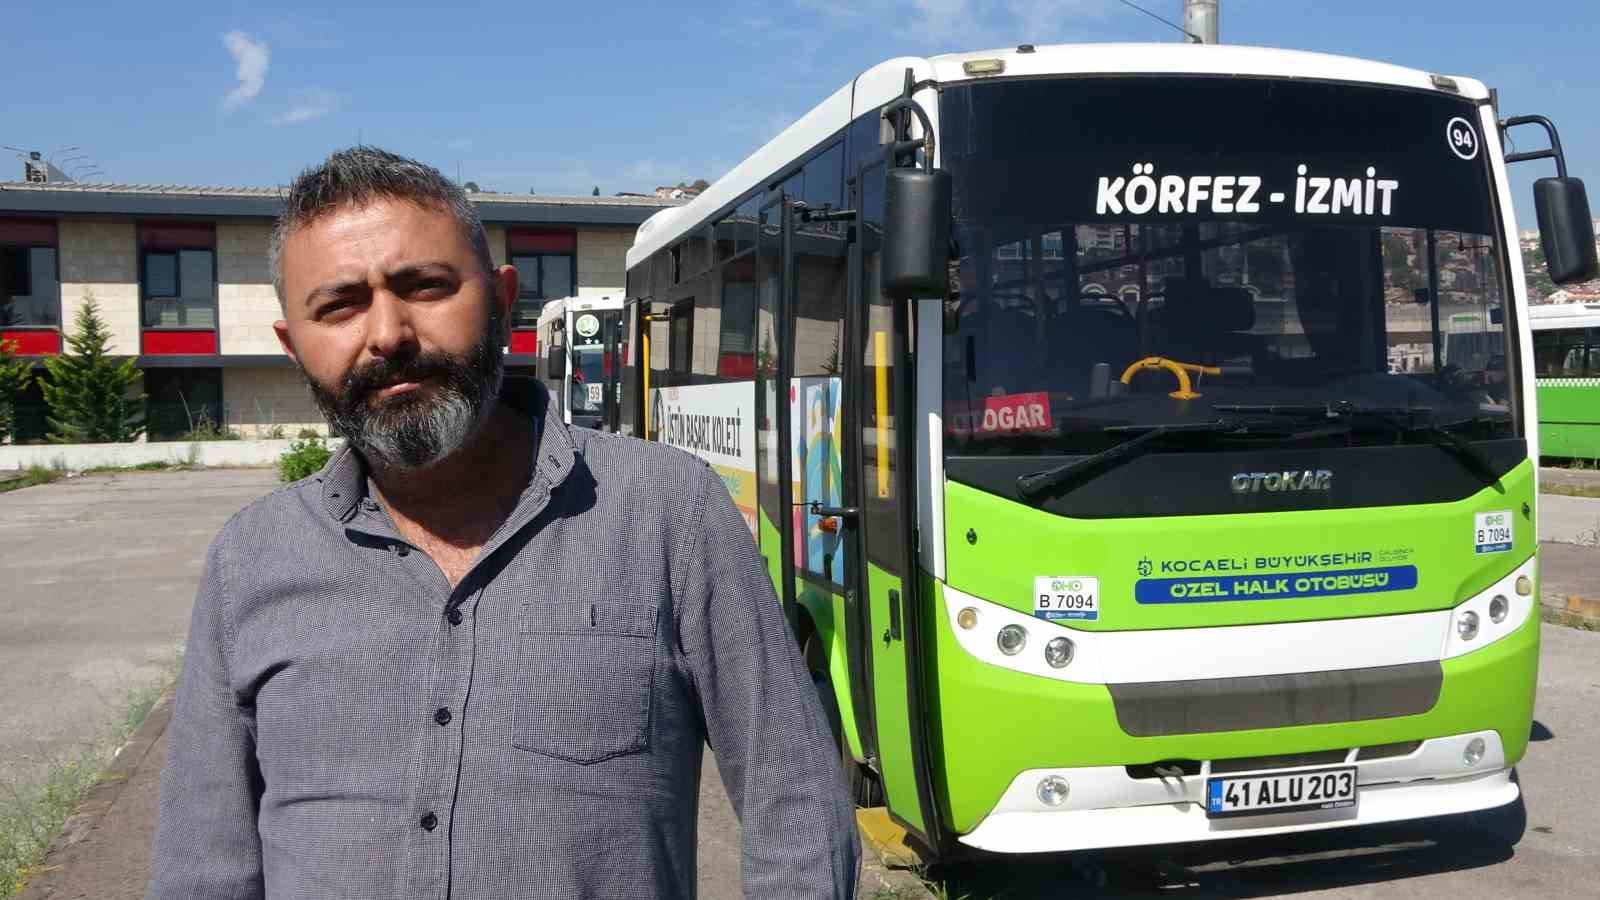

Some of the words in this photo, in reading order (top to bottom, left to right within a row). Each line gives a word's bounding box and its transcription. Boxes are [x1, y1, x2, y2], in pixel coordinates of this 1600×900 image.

[1453, 128, 1473, 148] 94
[1096, 162, 1262, 215] KÖRFEZ
[1294, 163, 1399, 215] İZMİT
[1231, 469, 1333, 493] OTOKAR
[1477, 529, 1485, 543] B
[1488, 527, 1510, 542] 7094
[1169, 580, 1229, 598] ÖZEL
[1233, 578, 1290, 595] HALK
[1294, 571, 1389, 592] OTOBÜSÜ
[1039, 594, 1051, 608] B
[1056, 593, 1094, 609] 7094
[1225, 781, 1251, 807] 41
[1257, 776, 1304, 806] ALU
[1307, 772, 1353, 801] 203
